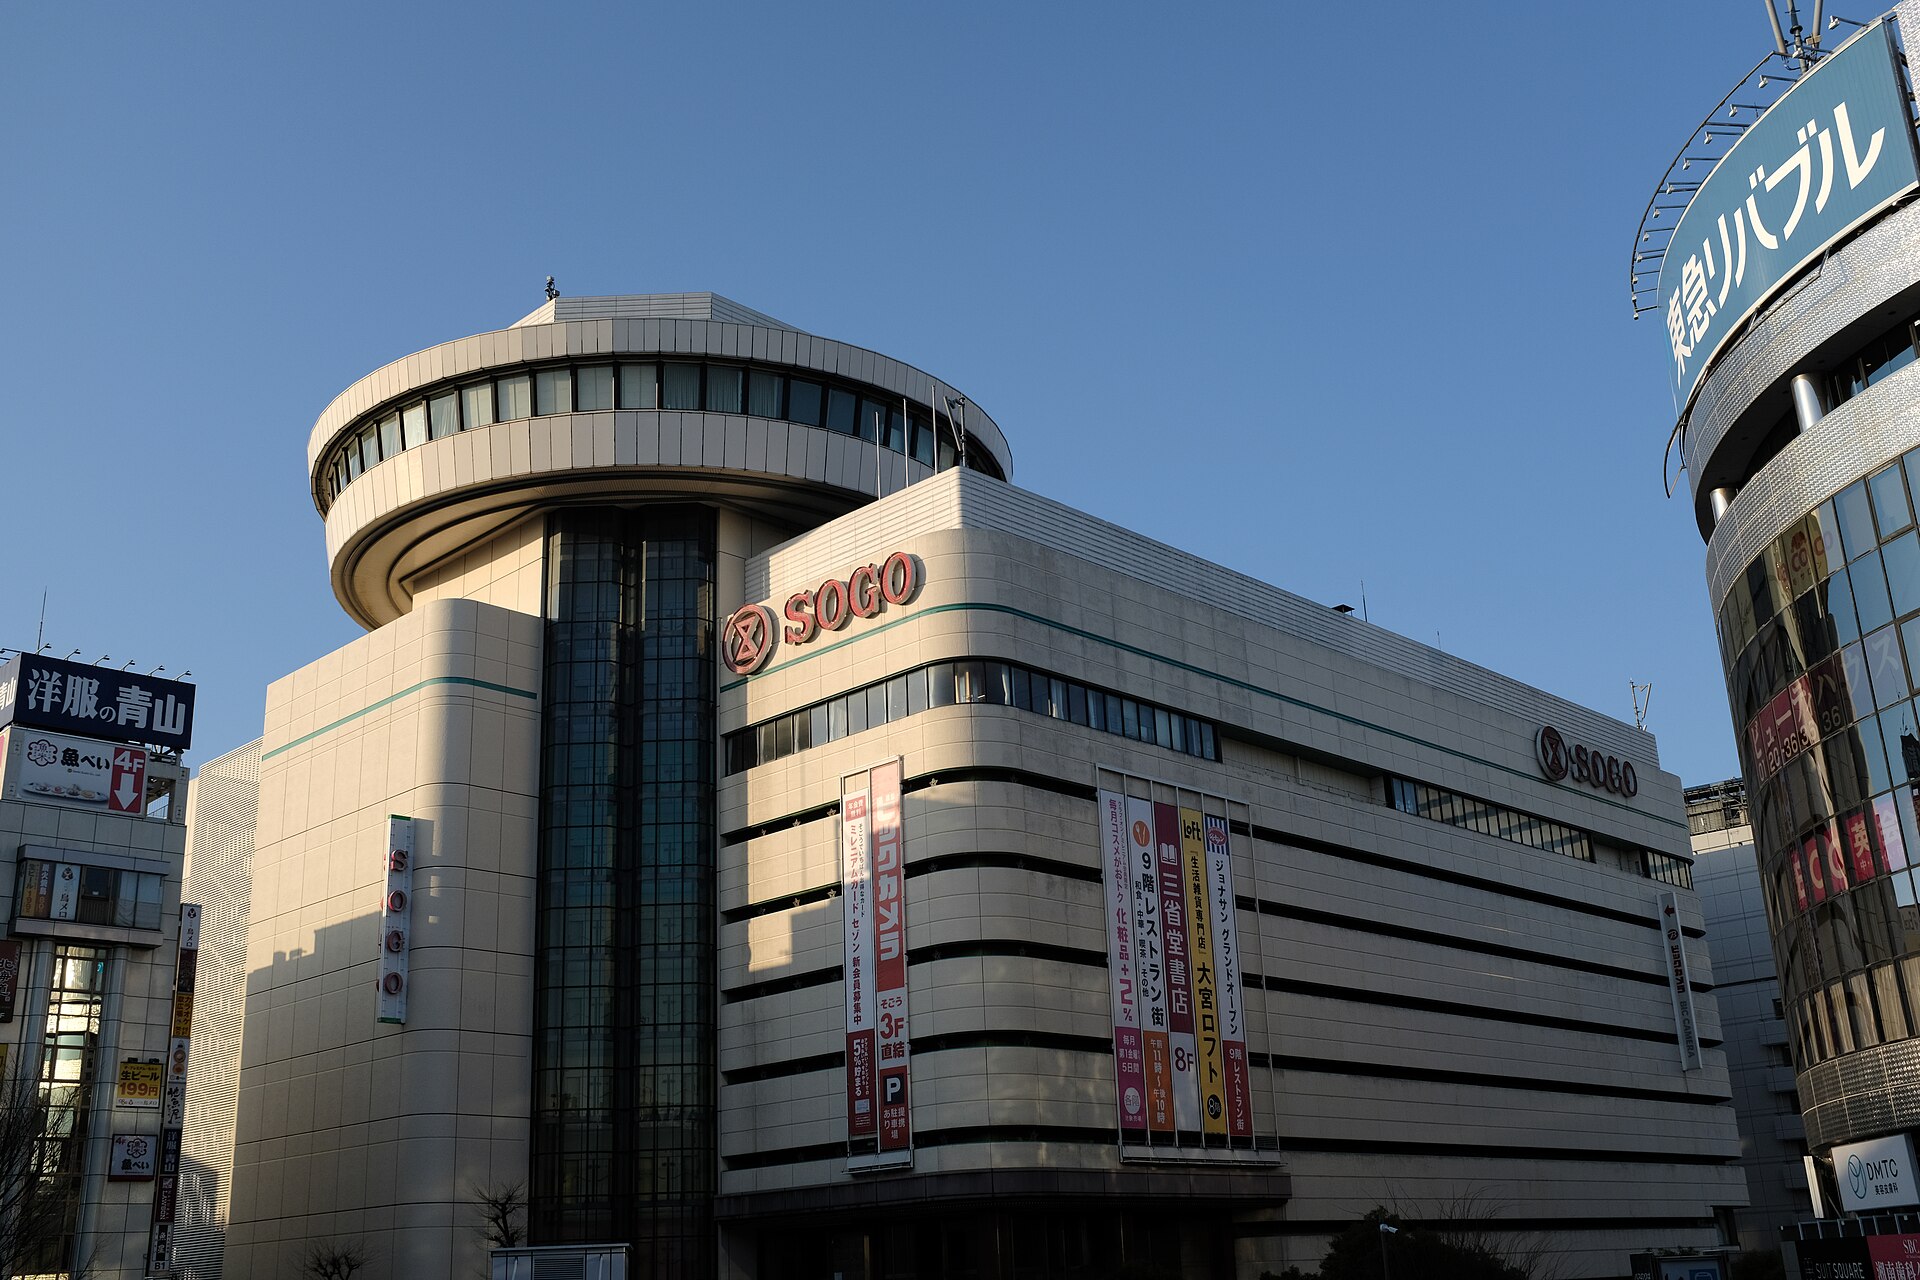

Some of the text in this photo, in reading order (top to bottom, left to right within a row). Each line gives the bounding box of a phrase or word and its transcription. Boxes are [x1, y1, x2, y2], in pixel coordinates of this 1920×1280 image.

[1666, 102, 1886, 389] 東急リバブル
[785, 551, 917, 645] SOGO
[27, 668, 187, 736] 洋服の青山
[60, 747, 110, 770] 魚べい
[114, 750, 145, 773] 4F
[1569, 744, 1638, 798] SOGO
[876, 794, 900, 961] ビックカメラ
[384, 849, 408, 995] SOGO
[1141, 852, 1165, 1028] 9階レストラン街
[1162, 872, 1188, 1015] 三省堂書店
[1221, 928, 1238, 1036] グランドオープン
[880, 996, 903, 1010] そごう
[880, 1011, 905, 1040] 3F
[1197, 964, 1218, 1084] 大宮ロフト
[1122, 1034, 1136, 1046] 毎月
[1683, 1018, 1695, 1059] CAMERA
[881, 1042, 906, 1061] 直結
[1174, 1047, 1194, 1073] 8F
[120, 1070, 160, 1081] 生ビール
[1122, 1062, 1140, 1074] 5日間
[119, 1081, 158, 1097] 199円
[886, 1076, 901, 1102] P
[883, 1108, 891, 1130] あり
[121, 1159, 149, 1171] 魚べい
[1866, 1158, 1898, 1181] DMTC
[1903, 1238, 1920, 1255] SBC
[154, 1261, 166, 1270] B1
[1815, 1262, 1832, 1280] SUIT
[1832, 1262, 1865, 1280] SQUARE
